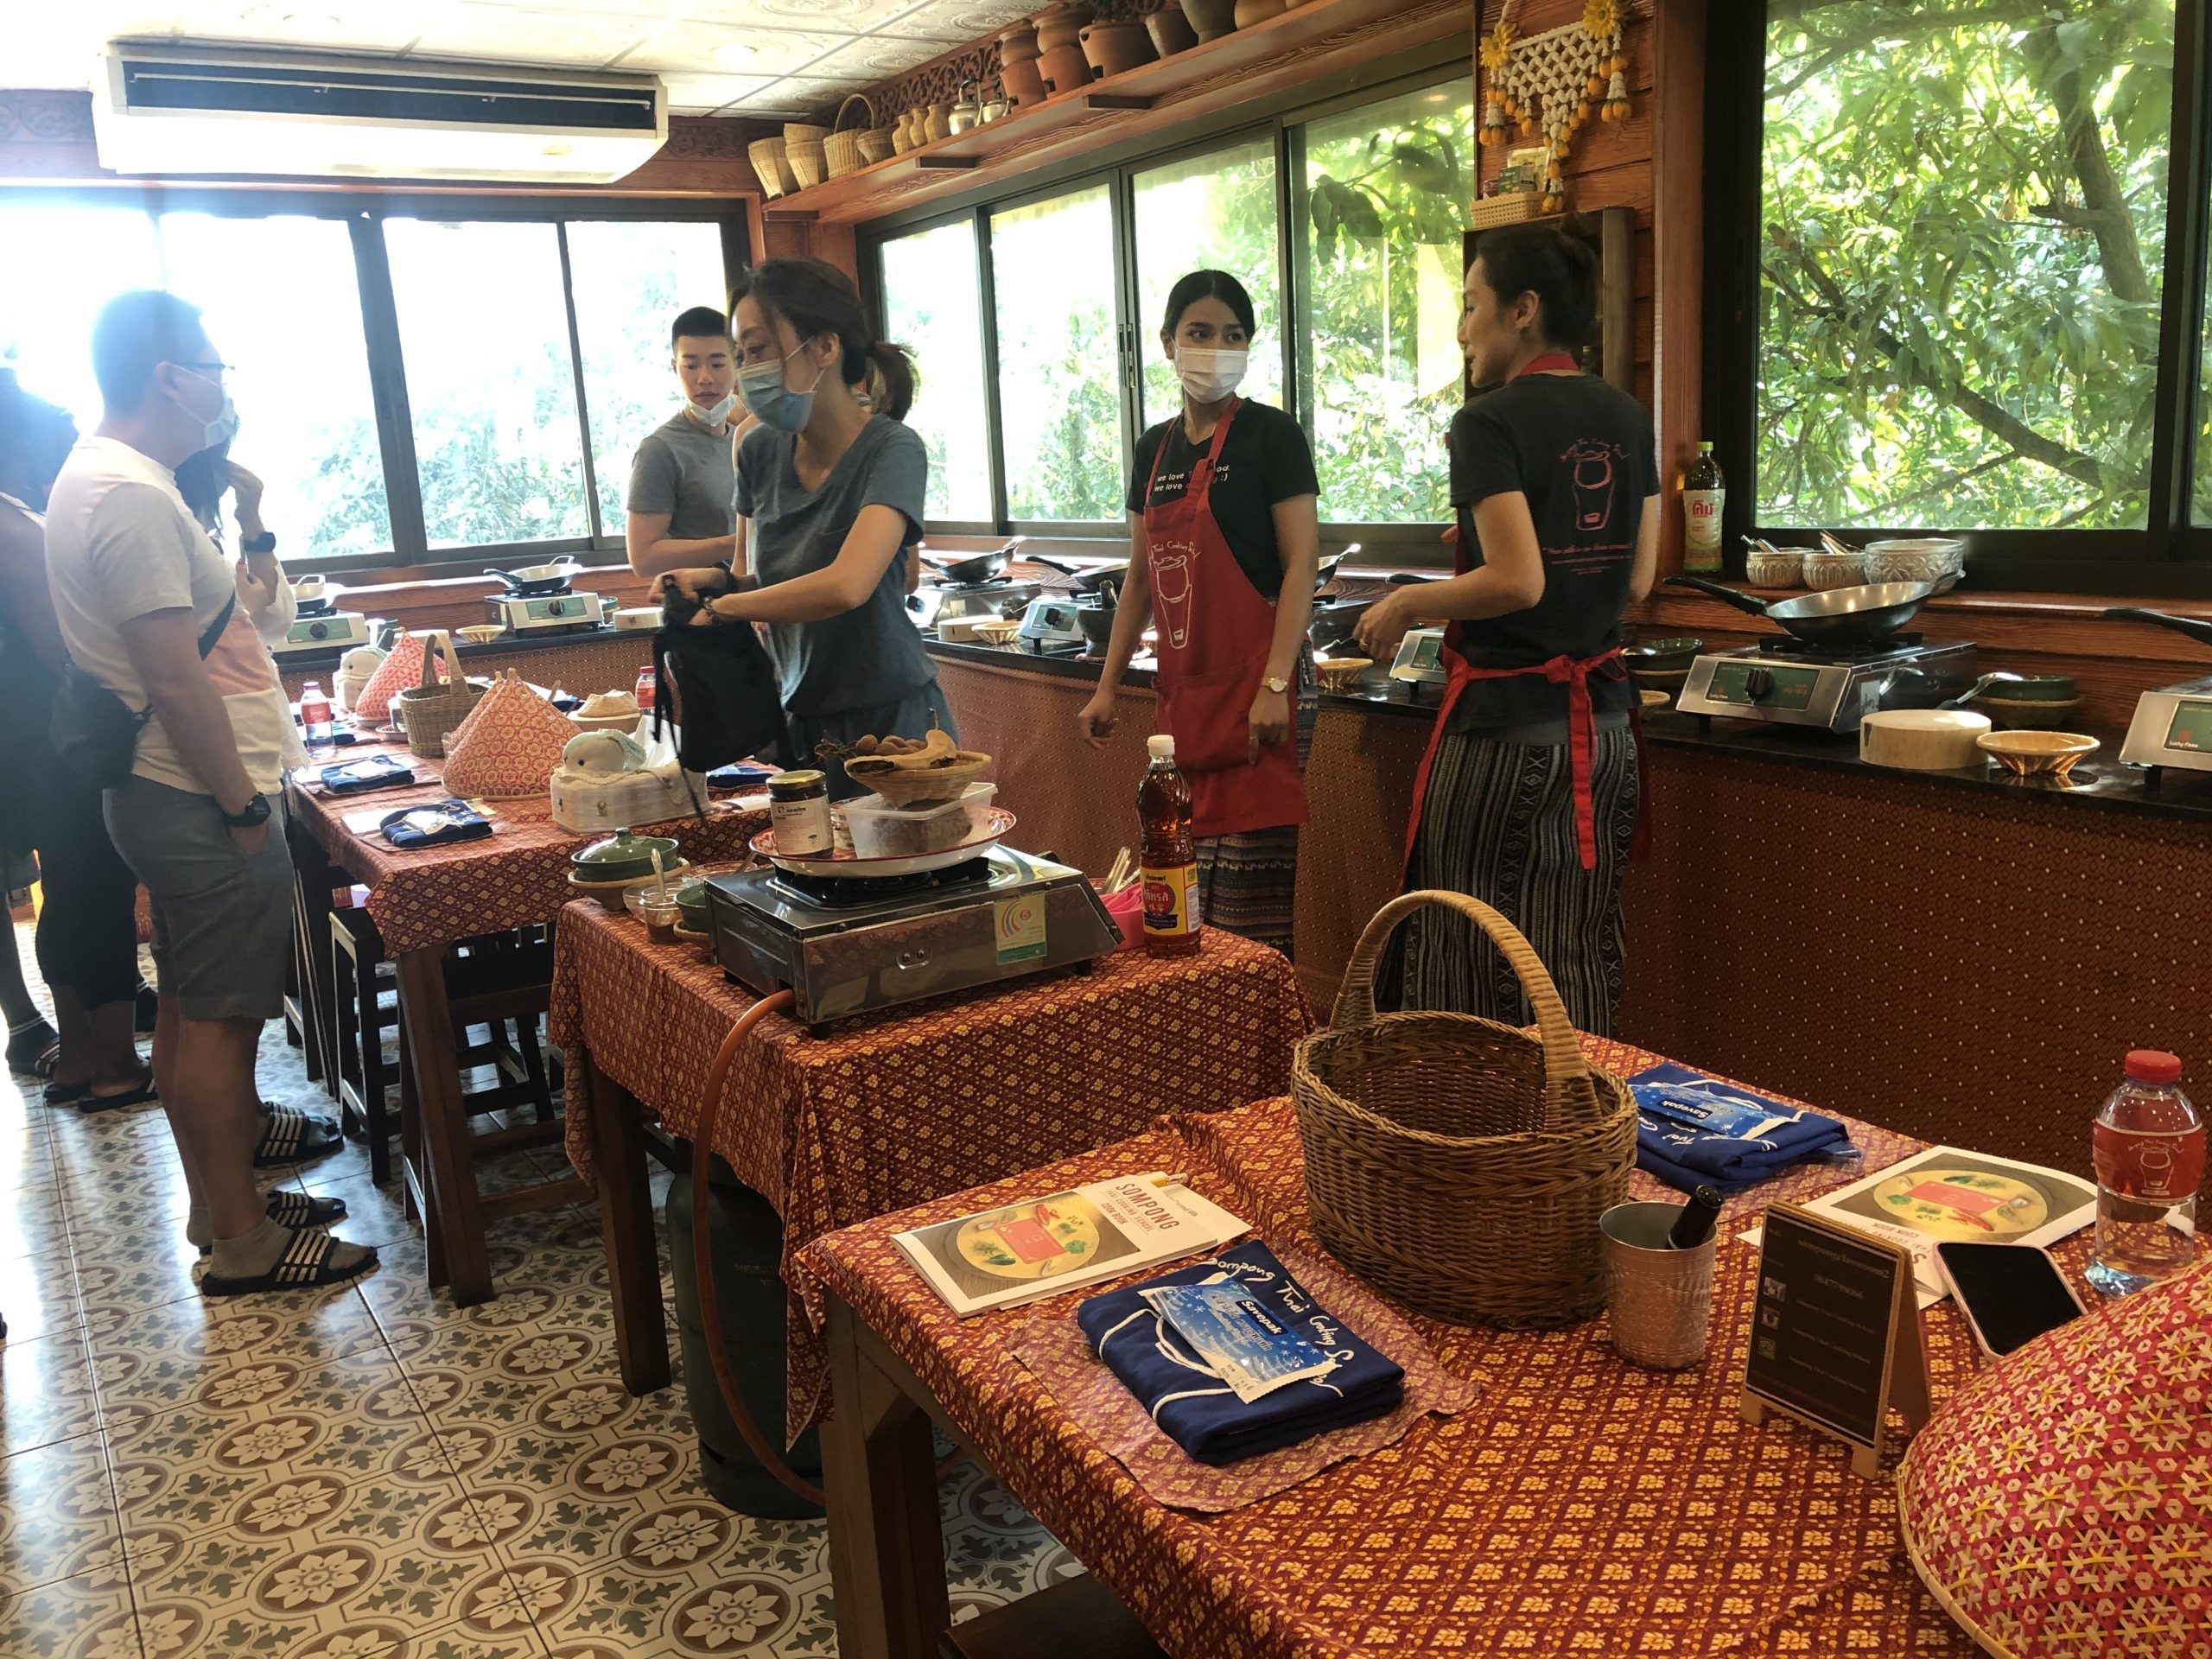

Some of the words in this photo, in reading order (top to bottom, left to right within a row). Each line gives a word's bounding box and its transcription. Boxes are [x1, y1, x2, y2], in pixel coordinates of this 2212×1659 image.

[1169, 473, 1185, 481] love
[1661, 1099, 1709, 1119] Savepak
[1100, 1202, 1116, 1212] COOK
[1111, 1211, 1129, 1226] BOOK
[1116, 1183, 1180, 1230] SOMPONG
[1134, 1215, 1154, 1232] SCHOOL
[1897, 1229, 1919, 1239] COOK
[1275, 1280, 1311, 1314] Thai
[1241, 1299, 1283, 1335] Savepak
